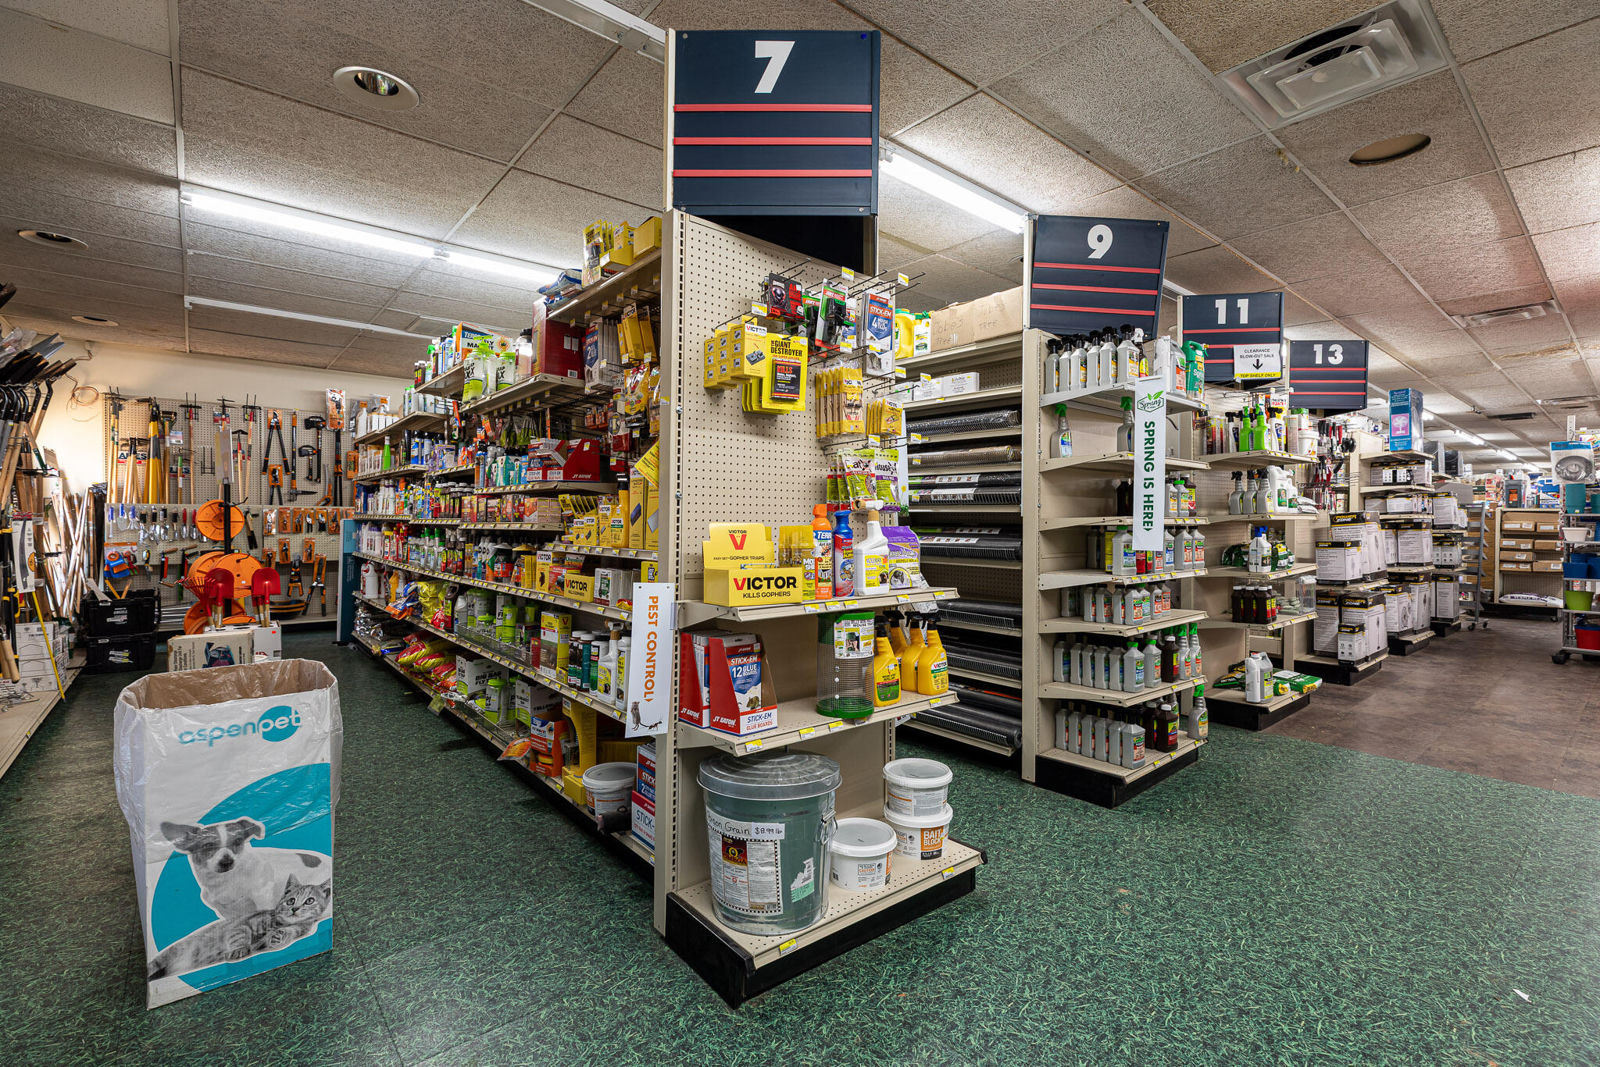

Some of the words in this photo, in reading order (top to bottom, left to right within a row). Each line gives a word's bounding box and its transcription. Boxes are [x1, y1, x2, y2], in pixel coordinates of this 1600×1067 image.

[754, 40, 796, 94] 7
[1086, 224, 1114, 259] 9
[1215, 298, 1250, 325] 11
[871, 316, 878, 329] 4
[775, 340, 791, 348] GIANT
[771, 347, 803, 357] DESTROYER
[1313, 343, 1344, 365] 13
[1143, 421, 1156, 473] SPRING
[1143, 477, 1155, 489] IS
[1143, 494, 1154, 528] HERE
[728, 534, 747, 550] V
[566, 579, 588, 592] VICTOR
[733, 576, 797, 591] VICTOR
[648, 595, 659, 627] PEST
[644, 631, 658, 698] CONTROL
[731, 655, 758, 666] STICK-EM
[732, 666, 743, 678] 12
[743, 664, 757, 672] GLUE
[747, 712, 772, 723] STICK-EM
[178, 705, 304, 748] aspenpet
[757, 721, 773, 729] BOARDS
[724, 821, 750, 835] Grain
[754, 826, 775, 835] $8.99
[923, 830, 942, 840] BAIT
